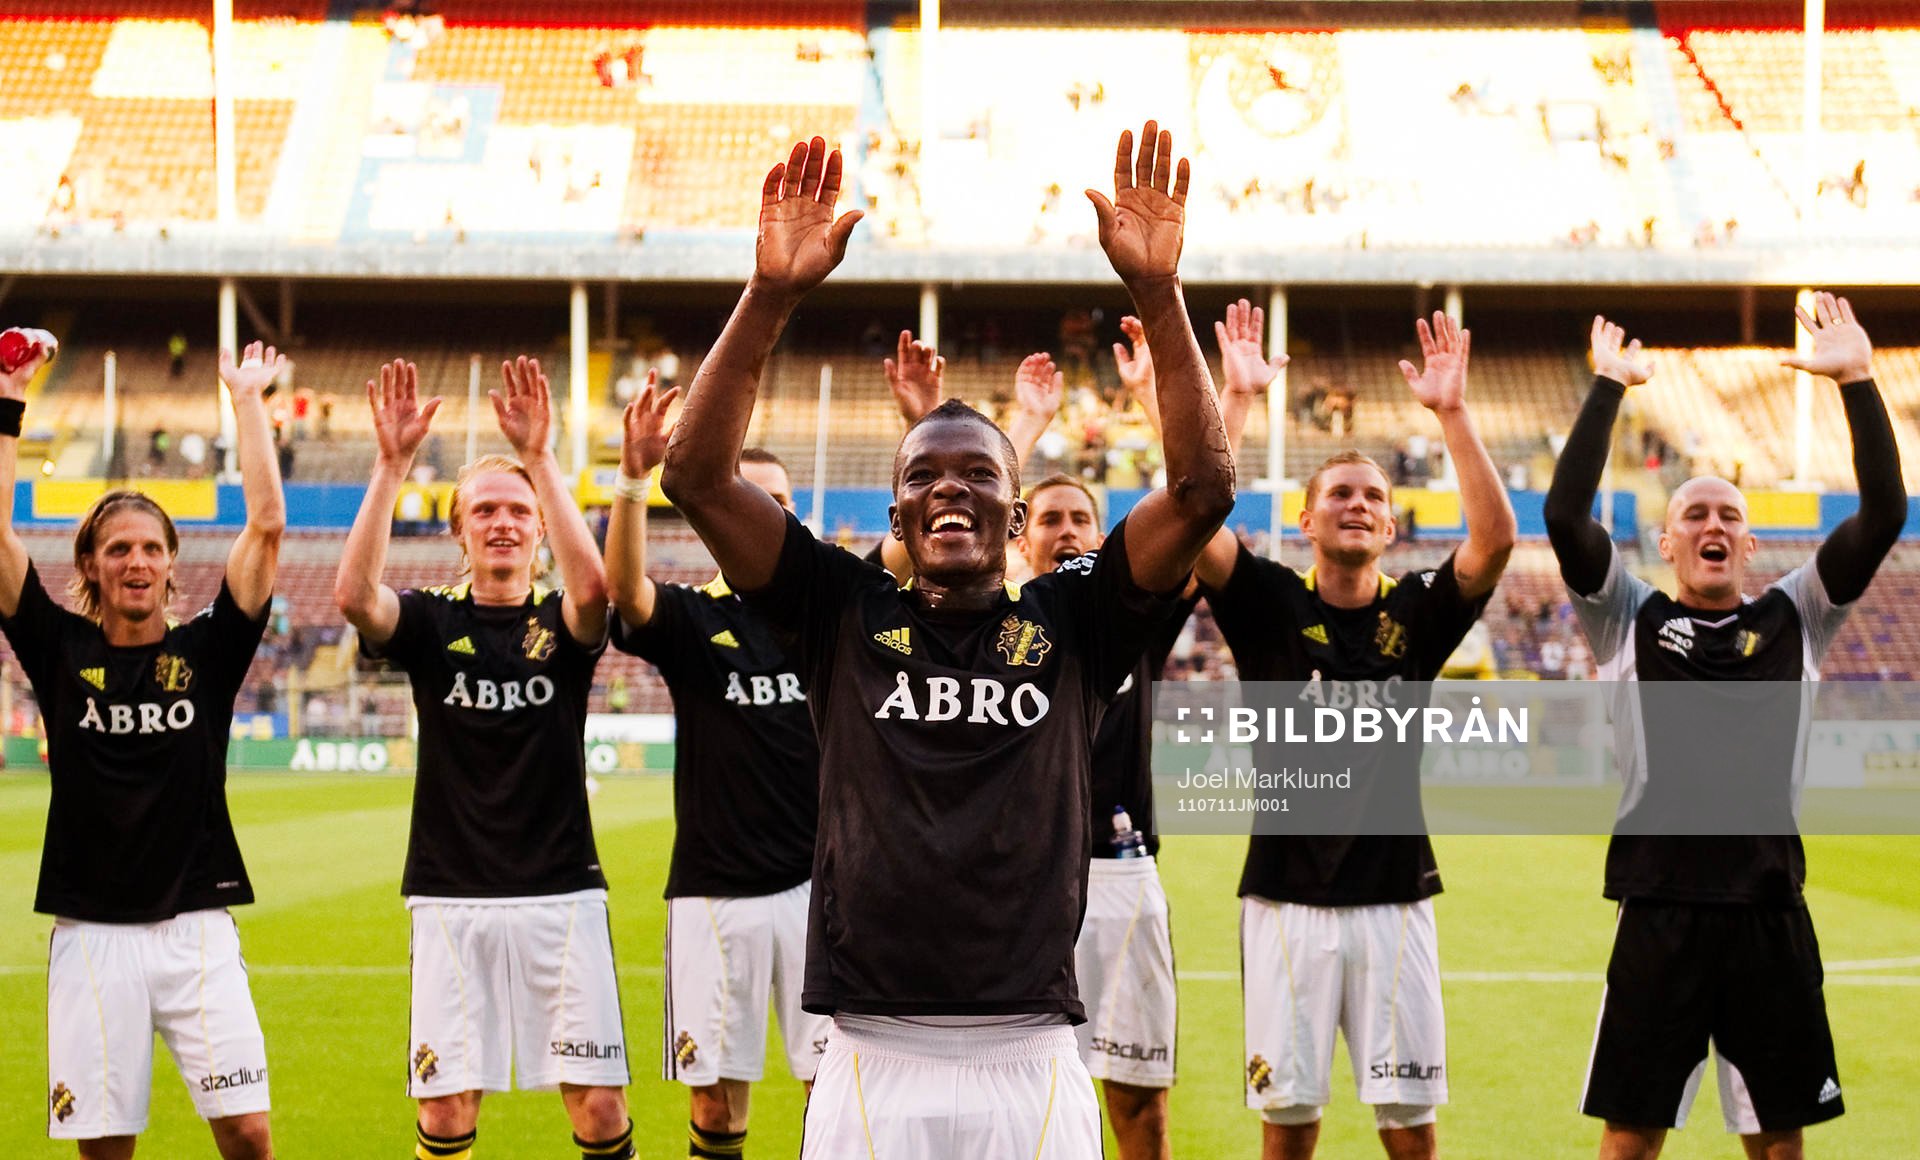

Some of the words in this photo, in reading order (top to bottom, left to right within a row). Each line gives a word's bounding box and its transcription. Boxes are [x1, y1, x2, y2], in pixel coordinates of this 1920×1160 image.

[873, 632, 913, 656] adidas
[444, 671, 555, 711] ÅBRO
[724, 671, 807, 706] ÅBR
[874, 670, 1051, 728] ÅBRO
[78, 696, 195, 735] ÅBRO
[291, 738, 389, 772] ÅBRO
[550, 1040, 623, 1060] stadium
[1090, 1036, 1168, 1062] stadium
